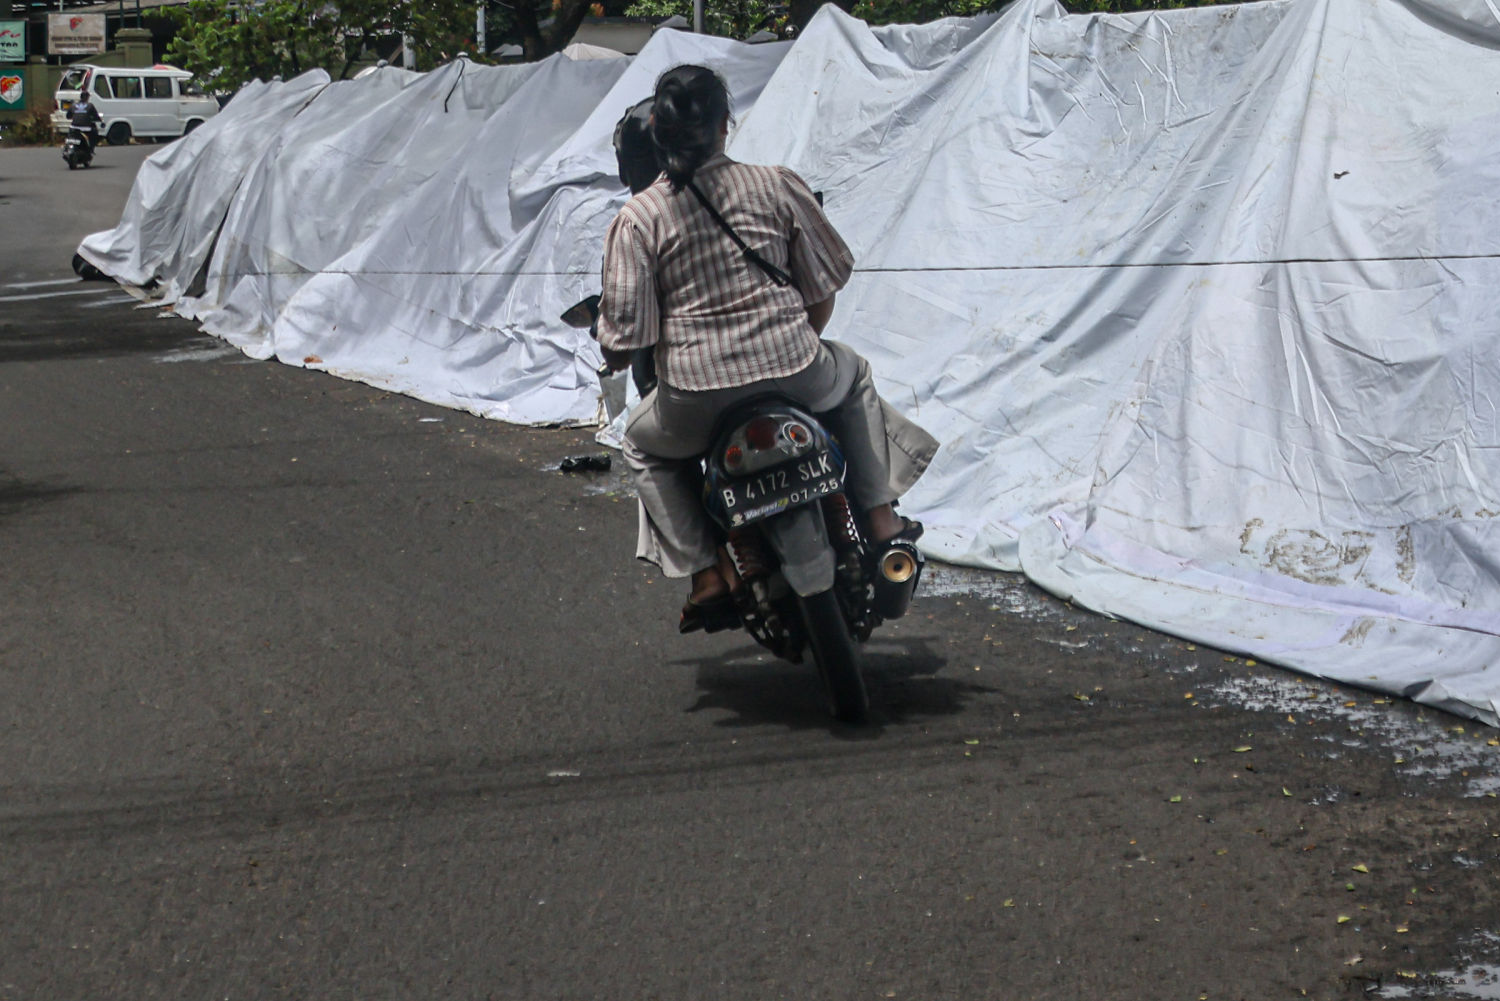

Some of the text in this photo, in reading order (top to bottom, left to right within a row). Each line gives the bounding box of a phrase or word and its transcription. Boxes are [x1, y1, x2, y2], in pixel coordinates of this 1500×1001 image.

[723, 452, 832, 508] B 4172 SLK
